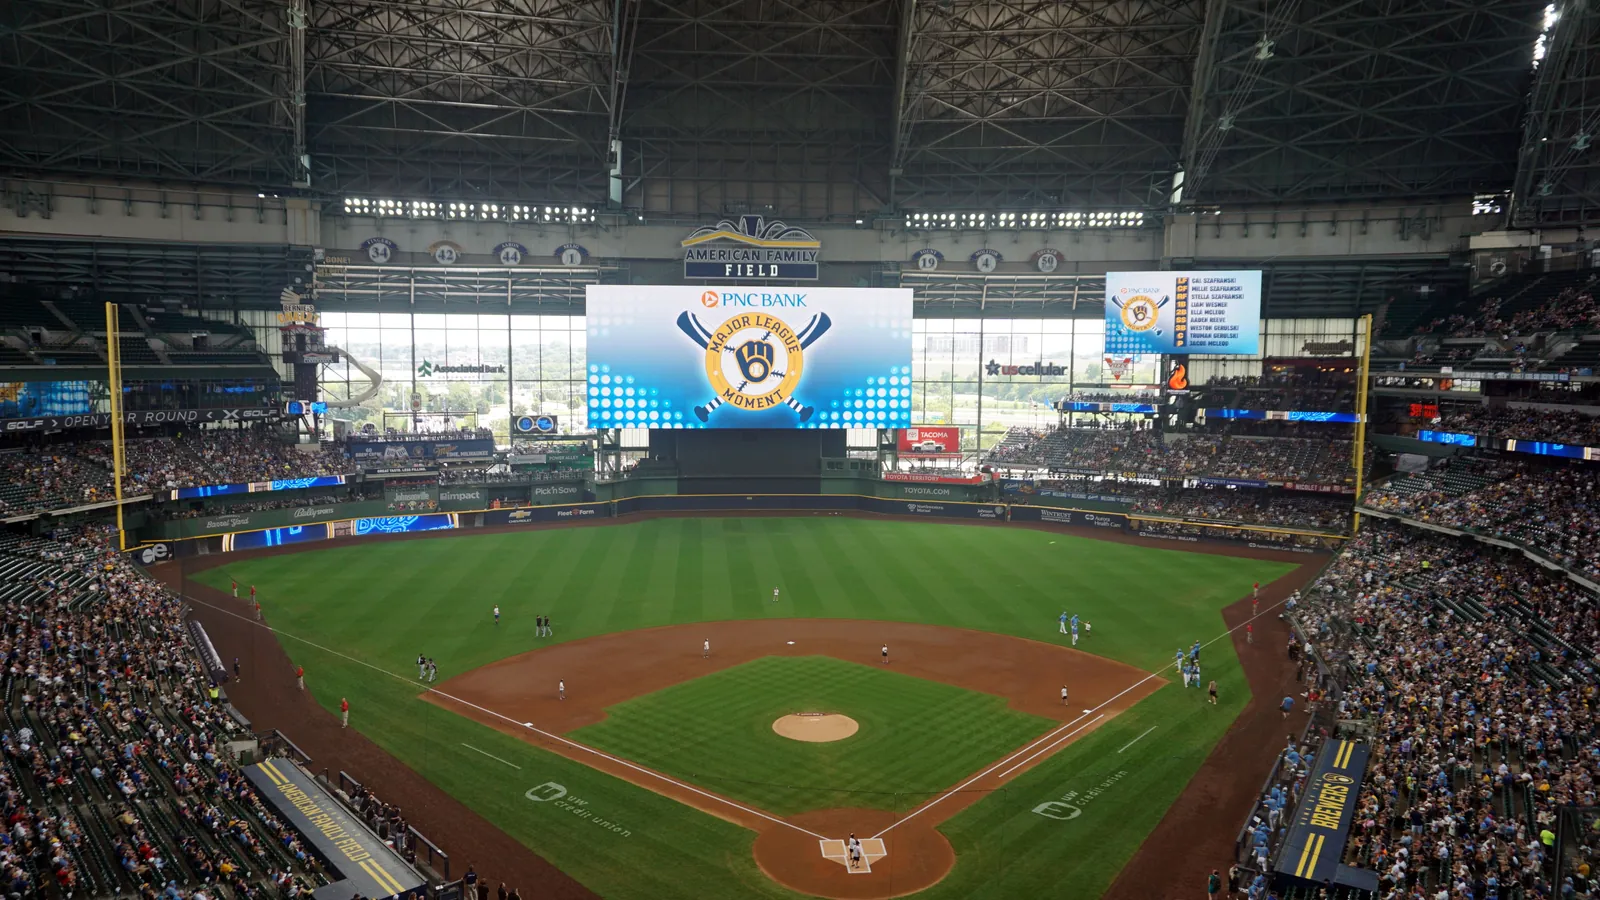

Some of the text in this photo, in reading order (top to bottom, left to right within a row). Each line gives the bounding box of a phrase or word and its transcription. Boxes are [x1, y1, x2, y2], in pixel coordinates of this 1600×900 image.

[372, 247, 388, 258] 34
[438, 249, 453, 260] 42
[502, 251, 518, 262] 44
[686, 249, 817, 262] AMERICAN FAMILY
[570, 254, 576, 264] 1
[922, 258, 935, 268] 19
[982, 258, 990, 268] 4
[1042, 256, 1054, 265] 50
[725, 264, 778, 276] FIELD
[721, 293, 807, 307] PNC BANK
[710, 315, 799, 354] MAJOR LEAGUE
[433, 364, 506, 373] Associated Bank
[723, 388, 783, 409] MOMENT
[7, 420, 43, 430] GOLF
[64, 415, 99, 427] OPEN
[145, 410, 198, 422] ROUND
[448, 491, 480, 500] impact
[904, 487, 950, 496] TOYOTA.COM
[294, 508, 317, 518] Bally
[1310, 783, 1349, 830] BREWERS
[277, 784, 324, 816] AMERICAN
[308, 813, 350, 840] FAMILY
[335, 838, 370, 862] FIELD
